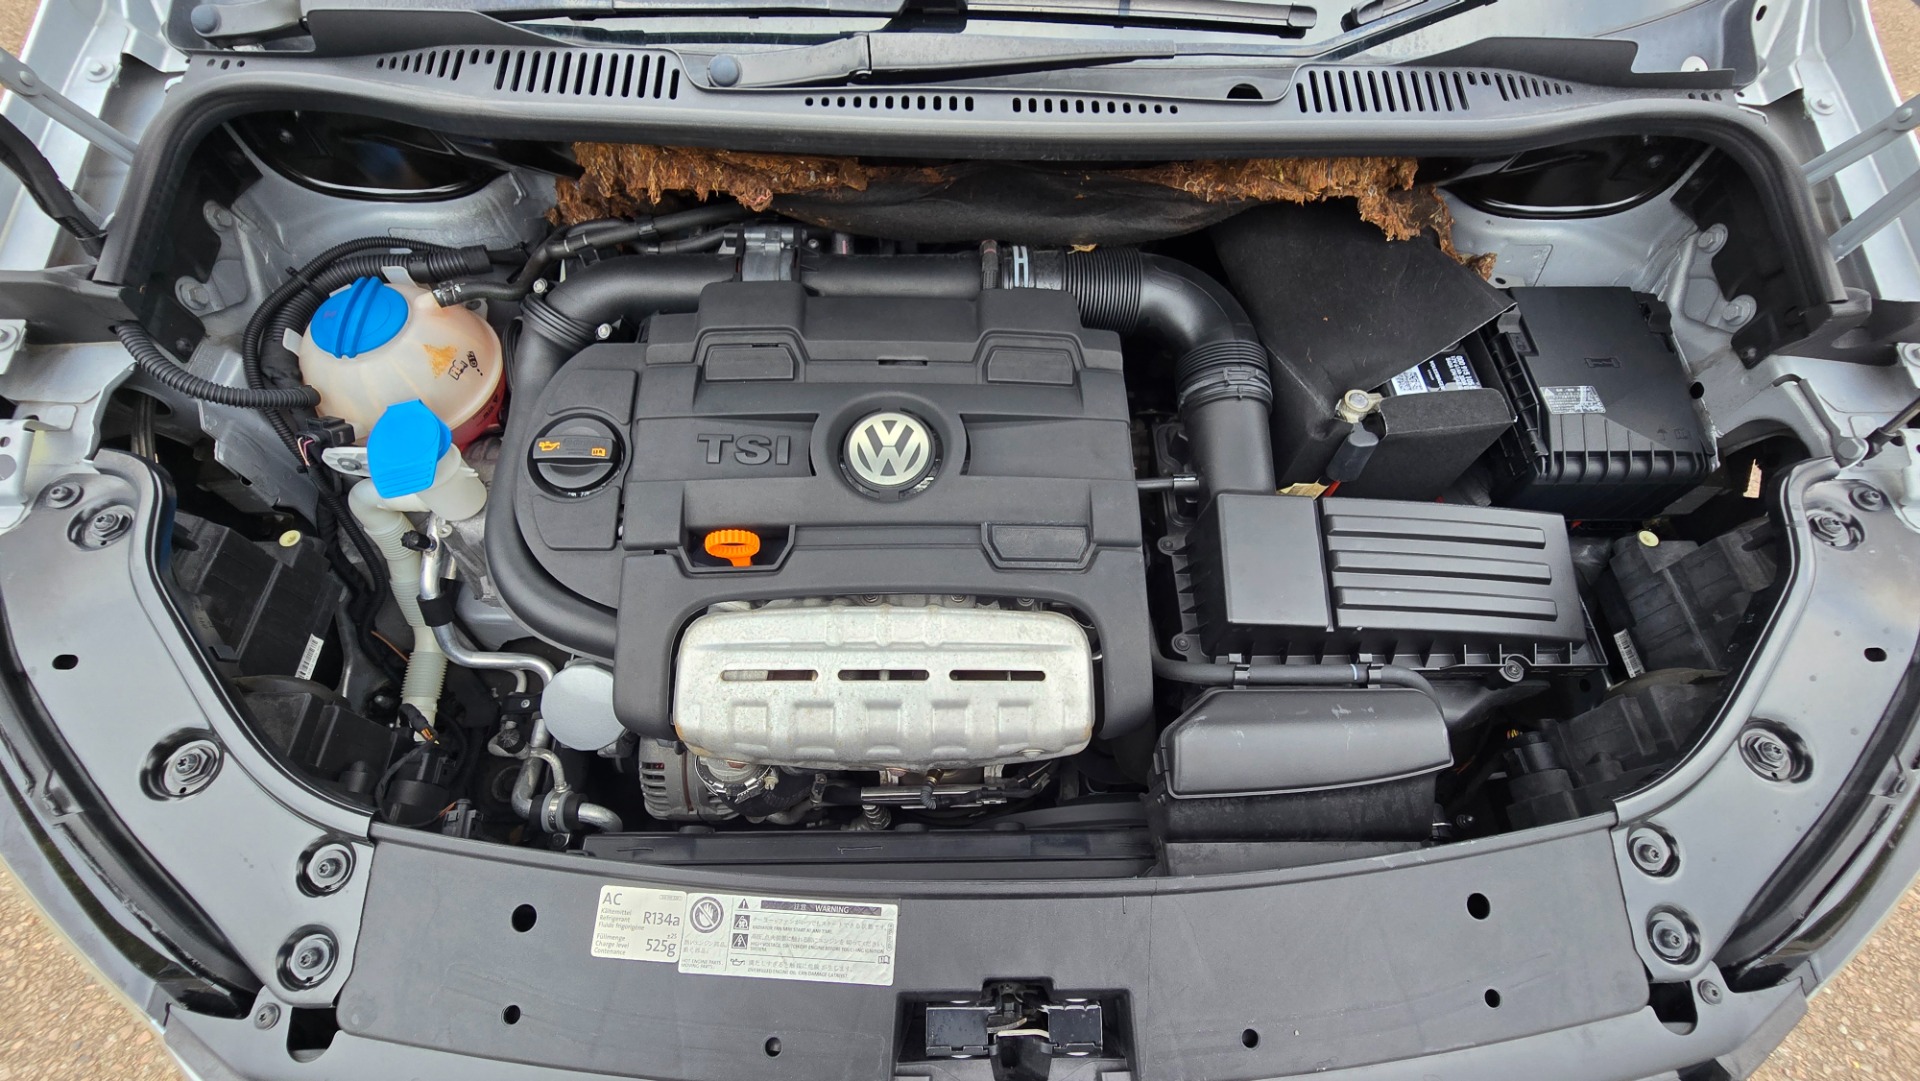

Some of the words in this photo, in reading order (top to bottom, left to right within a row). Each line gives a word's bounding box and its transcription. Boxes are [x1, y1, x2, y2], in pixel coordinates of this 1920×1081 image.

[697, 434, 791, 466] TSI
[602, 892, 622, 905] AC
[601, 908, 632, 916] Kältemittel
[815, 904, 850, 914] WARNING
[600, 915, 630, 923] Refrigerant
[643, 911, 680, 927] R134a
[597, 933, 626, 941] Füllmenge
[594, 948, 626, 956] Contenance
[645, 939, 676, 957] 525g
